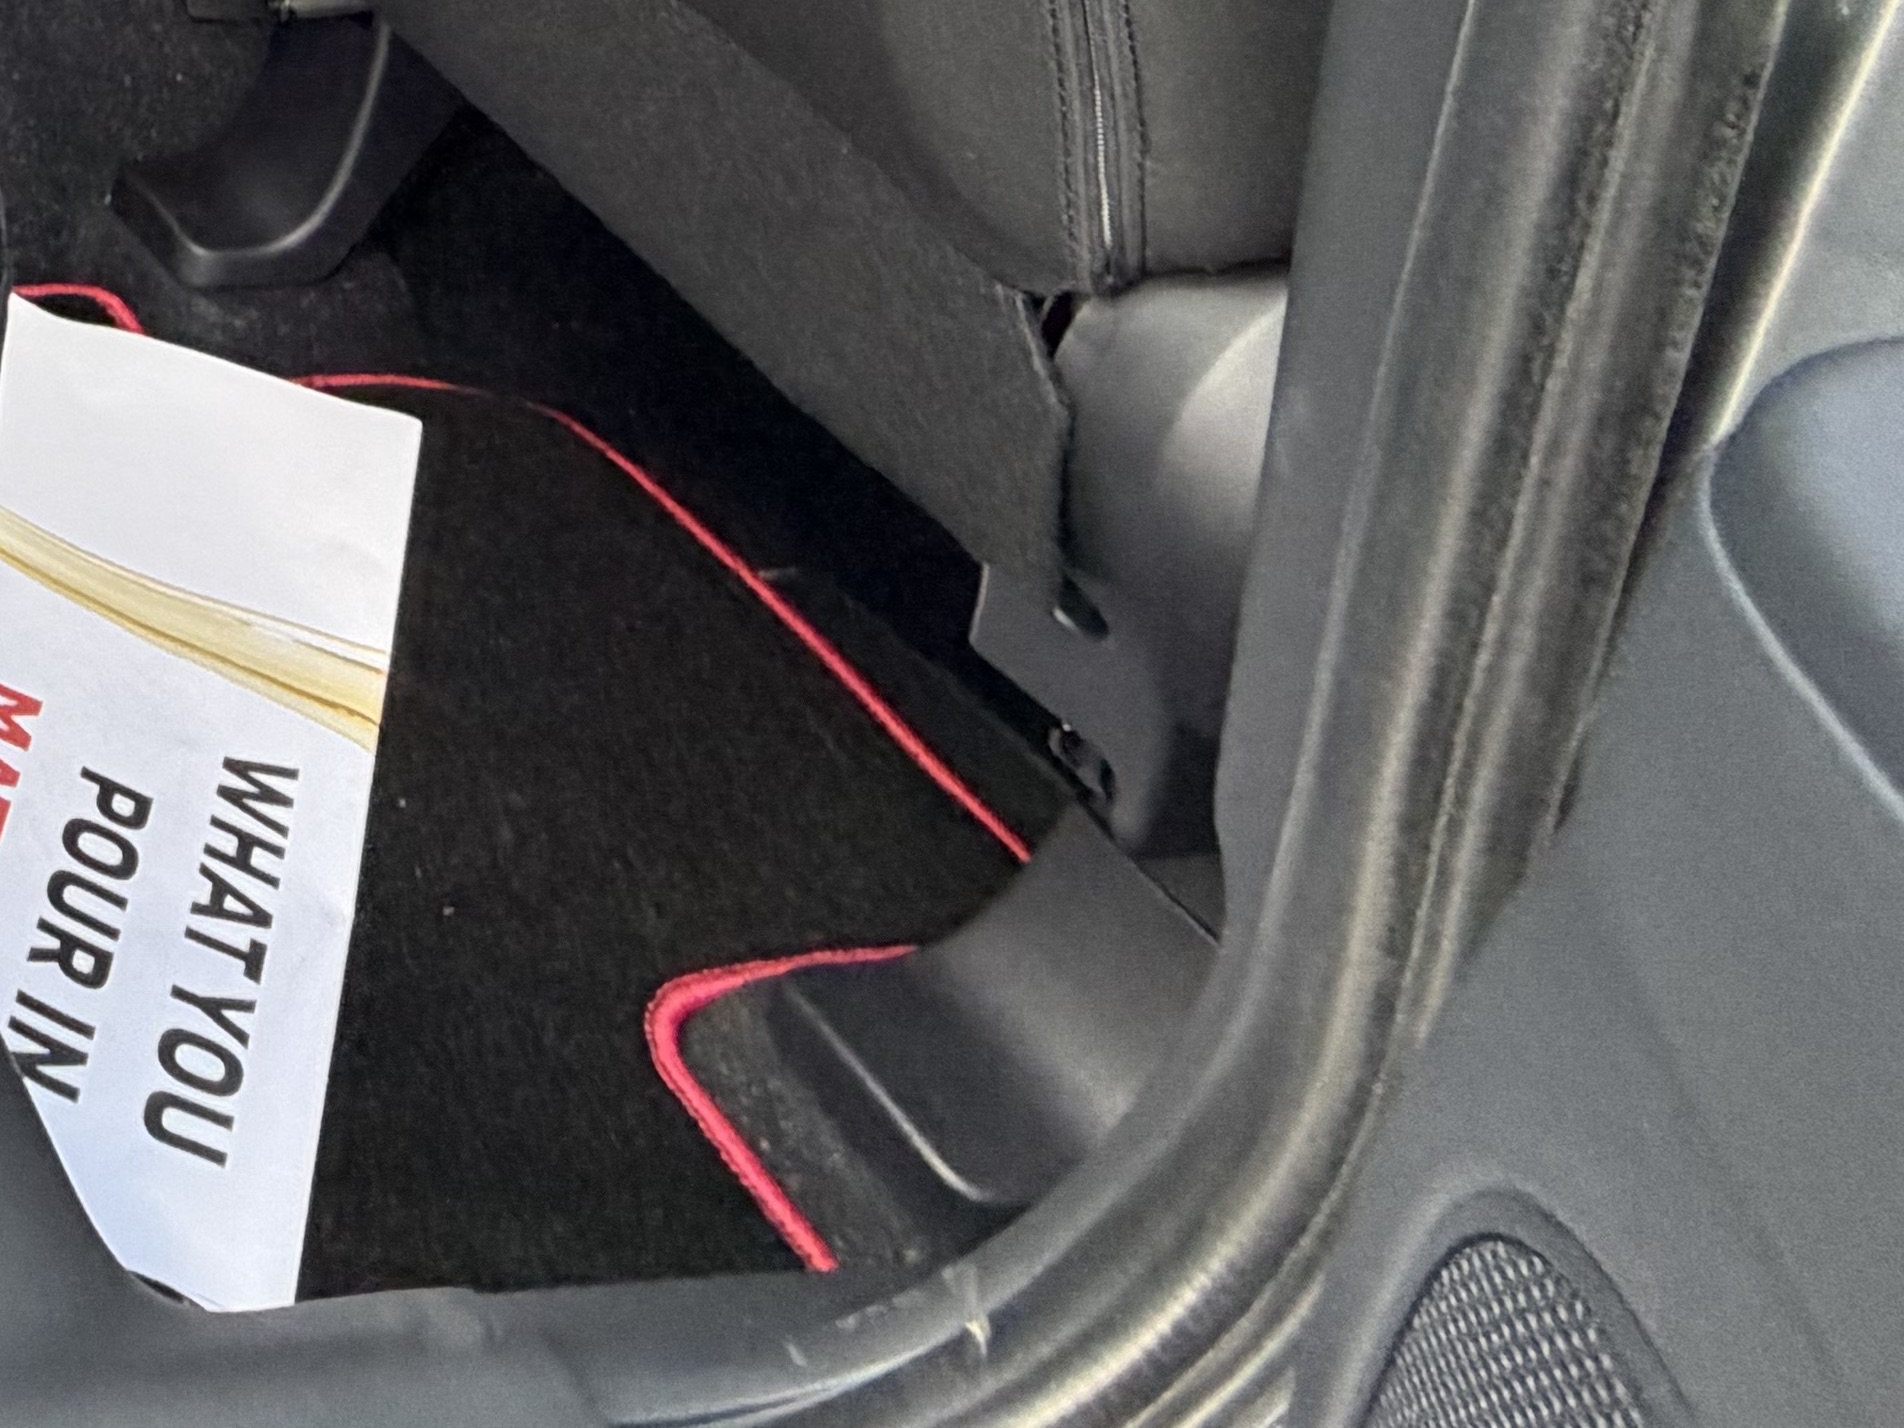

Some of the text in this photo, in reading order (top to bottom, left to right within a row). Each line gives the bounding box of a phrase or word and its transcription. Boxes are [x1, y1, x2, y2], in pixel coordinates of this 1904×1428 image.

[7, 766, 154, 1104] POUR IN
[143, 756, 299, 1168] WHAT YOU
